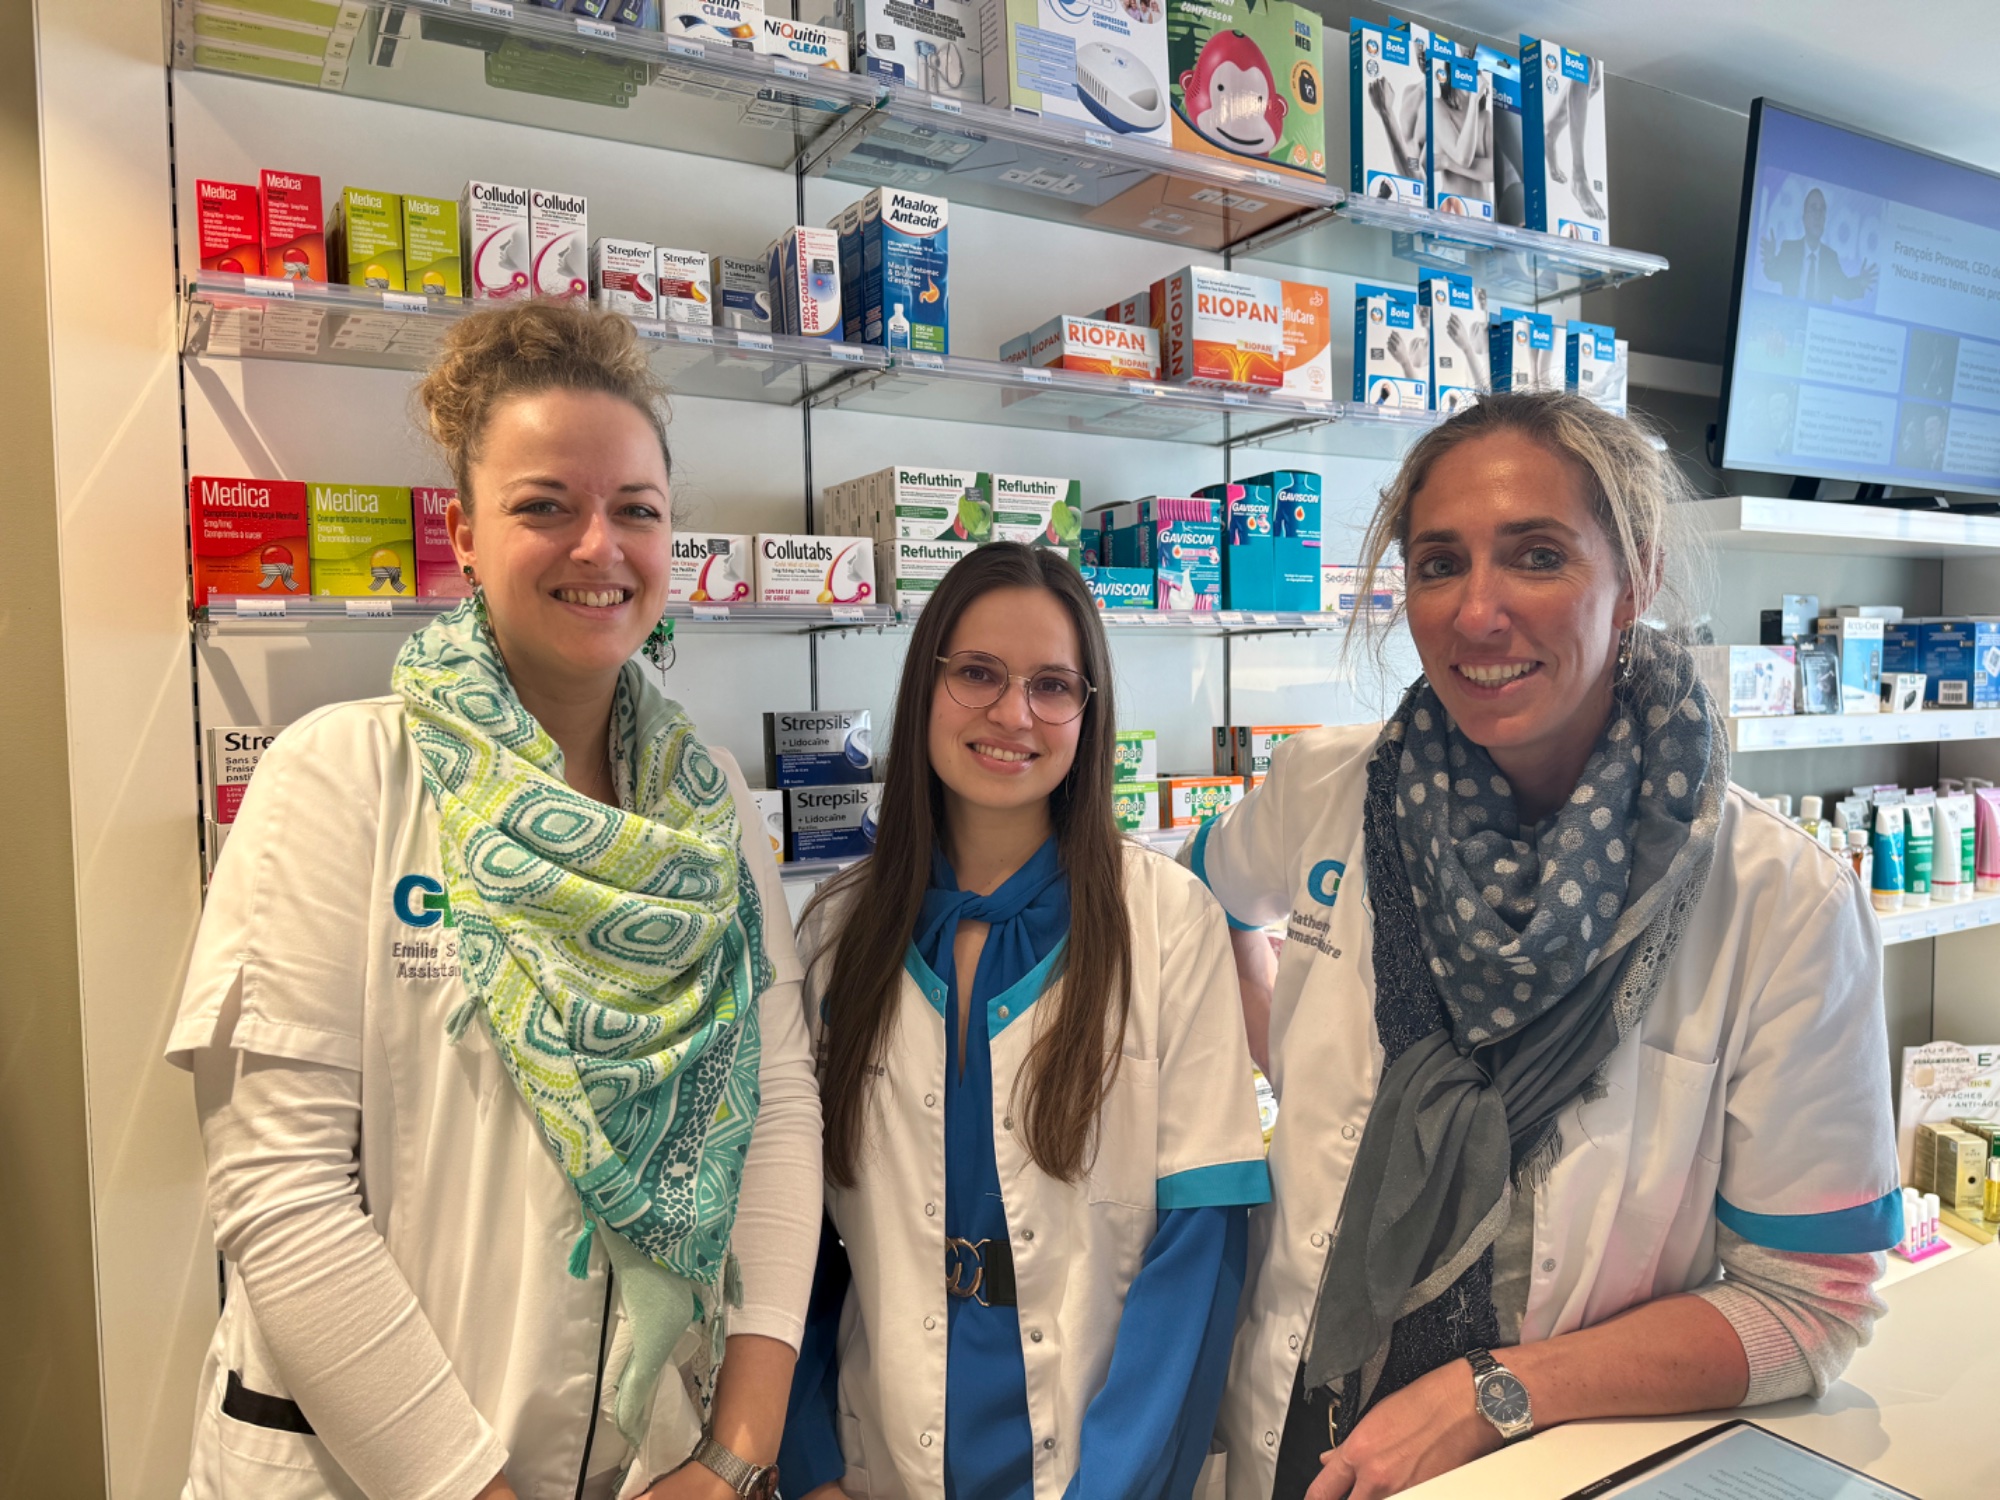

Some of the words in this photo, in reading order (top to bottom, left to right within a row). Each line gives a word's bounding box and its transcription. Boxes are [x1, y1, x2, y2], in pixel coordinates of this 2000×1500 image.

[702, 4, 741, 22] CLEAR
[1180, 2, 1233, 23] COMPRESSOR
[764, 20, 826, 44] NiQuitin
[788, 40, 827, 56] CLEAR
[1386, 41, 1406, 54] Bota
[1565, 55, 1584, 70] Bota
[1455, 70, 1473, 82] Bota
[266, 174, 302, 190] Medica
[202, 184, 236, 200] Medica
[350, 192, 382, 208] Medica
[474, 186, 526, 206] Colludol
[408, 200, 440, 216] Medica
[534, 193, 584, 214] Colludol
[892, 194, 938, 215] Maalox
[890, 209, 939, 228] Antacid
[607, 244, 650, 258] Strepfen
[1894, 240, 1932, 262] François
[1935, 251, 1970, 273] Provost,
[1972, 262, 1990, 276] CEO
[664, 253, 704, 266] Strepfen
[724, 259, 766, 274] Strepsils
[1921, 272, 1947, 288] avons
[1949, 278, 1968, 293] tenu
[1970, 284, 1986, 298] nos
[1452, 288, 1470, 300] Bota
[1198, 294, 1278, 324] RIOPAN
[1391, 307, 1410, 318] Bota
[1171, 276, 1183, 376] RIOPAN
[1068, 323, 1145, 353] RIOPAN
[1533, 329, 1550, 340] Bota
[1032, 332, 1060, 356] RIOPAN
[1244, 342, 1272, 352] RIOPAN
[1597, 342, 1612, 353] Bota
[1119, 358, 1148, 368] RIOPAN
[900, 472, 962, 488] Refluthin
[998, 479, 1056, 494] Refluthin
[202, 481, 270, 507] Medica
[316, 488, 378, 512] Medica
[1280, 492, 1319, 504] GAVISCON
[1232, 503, 1270, 512] GAVISCON
[1161, 532, 1214, 545] GAVISCON
[765, 540, 832, 560] Collutabs
[901, 544, 963, 560] Refluthin
[781, 715, 850, 734] Strepsils
[798, 790, 868, 809] Strepsils
[1184, 792, 1232, 804] Buscopan
[392, 942, 438, 958] Emilie
